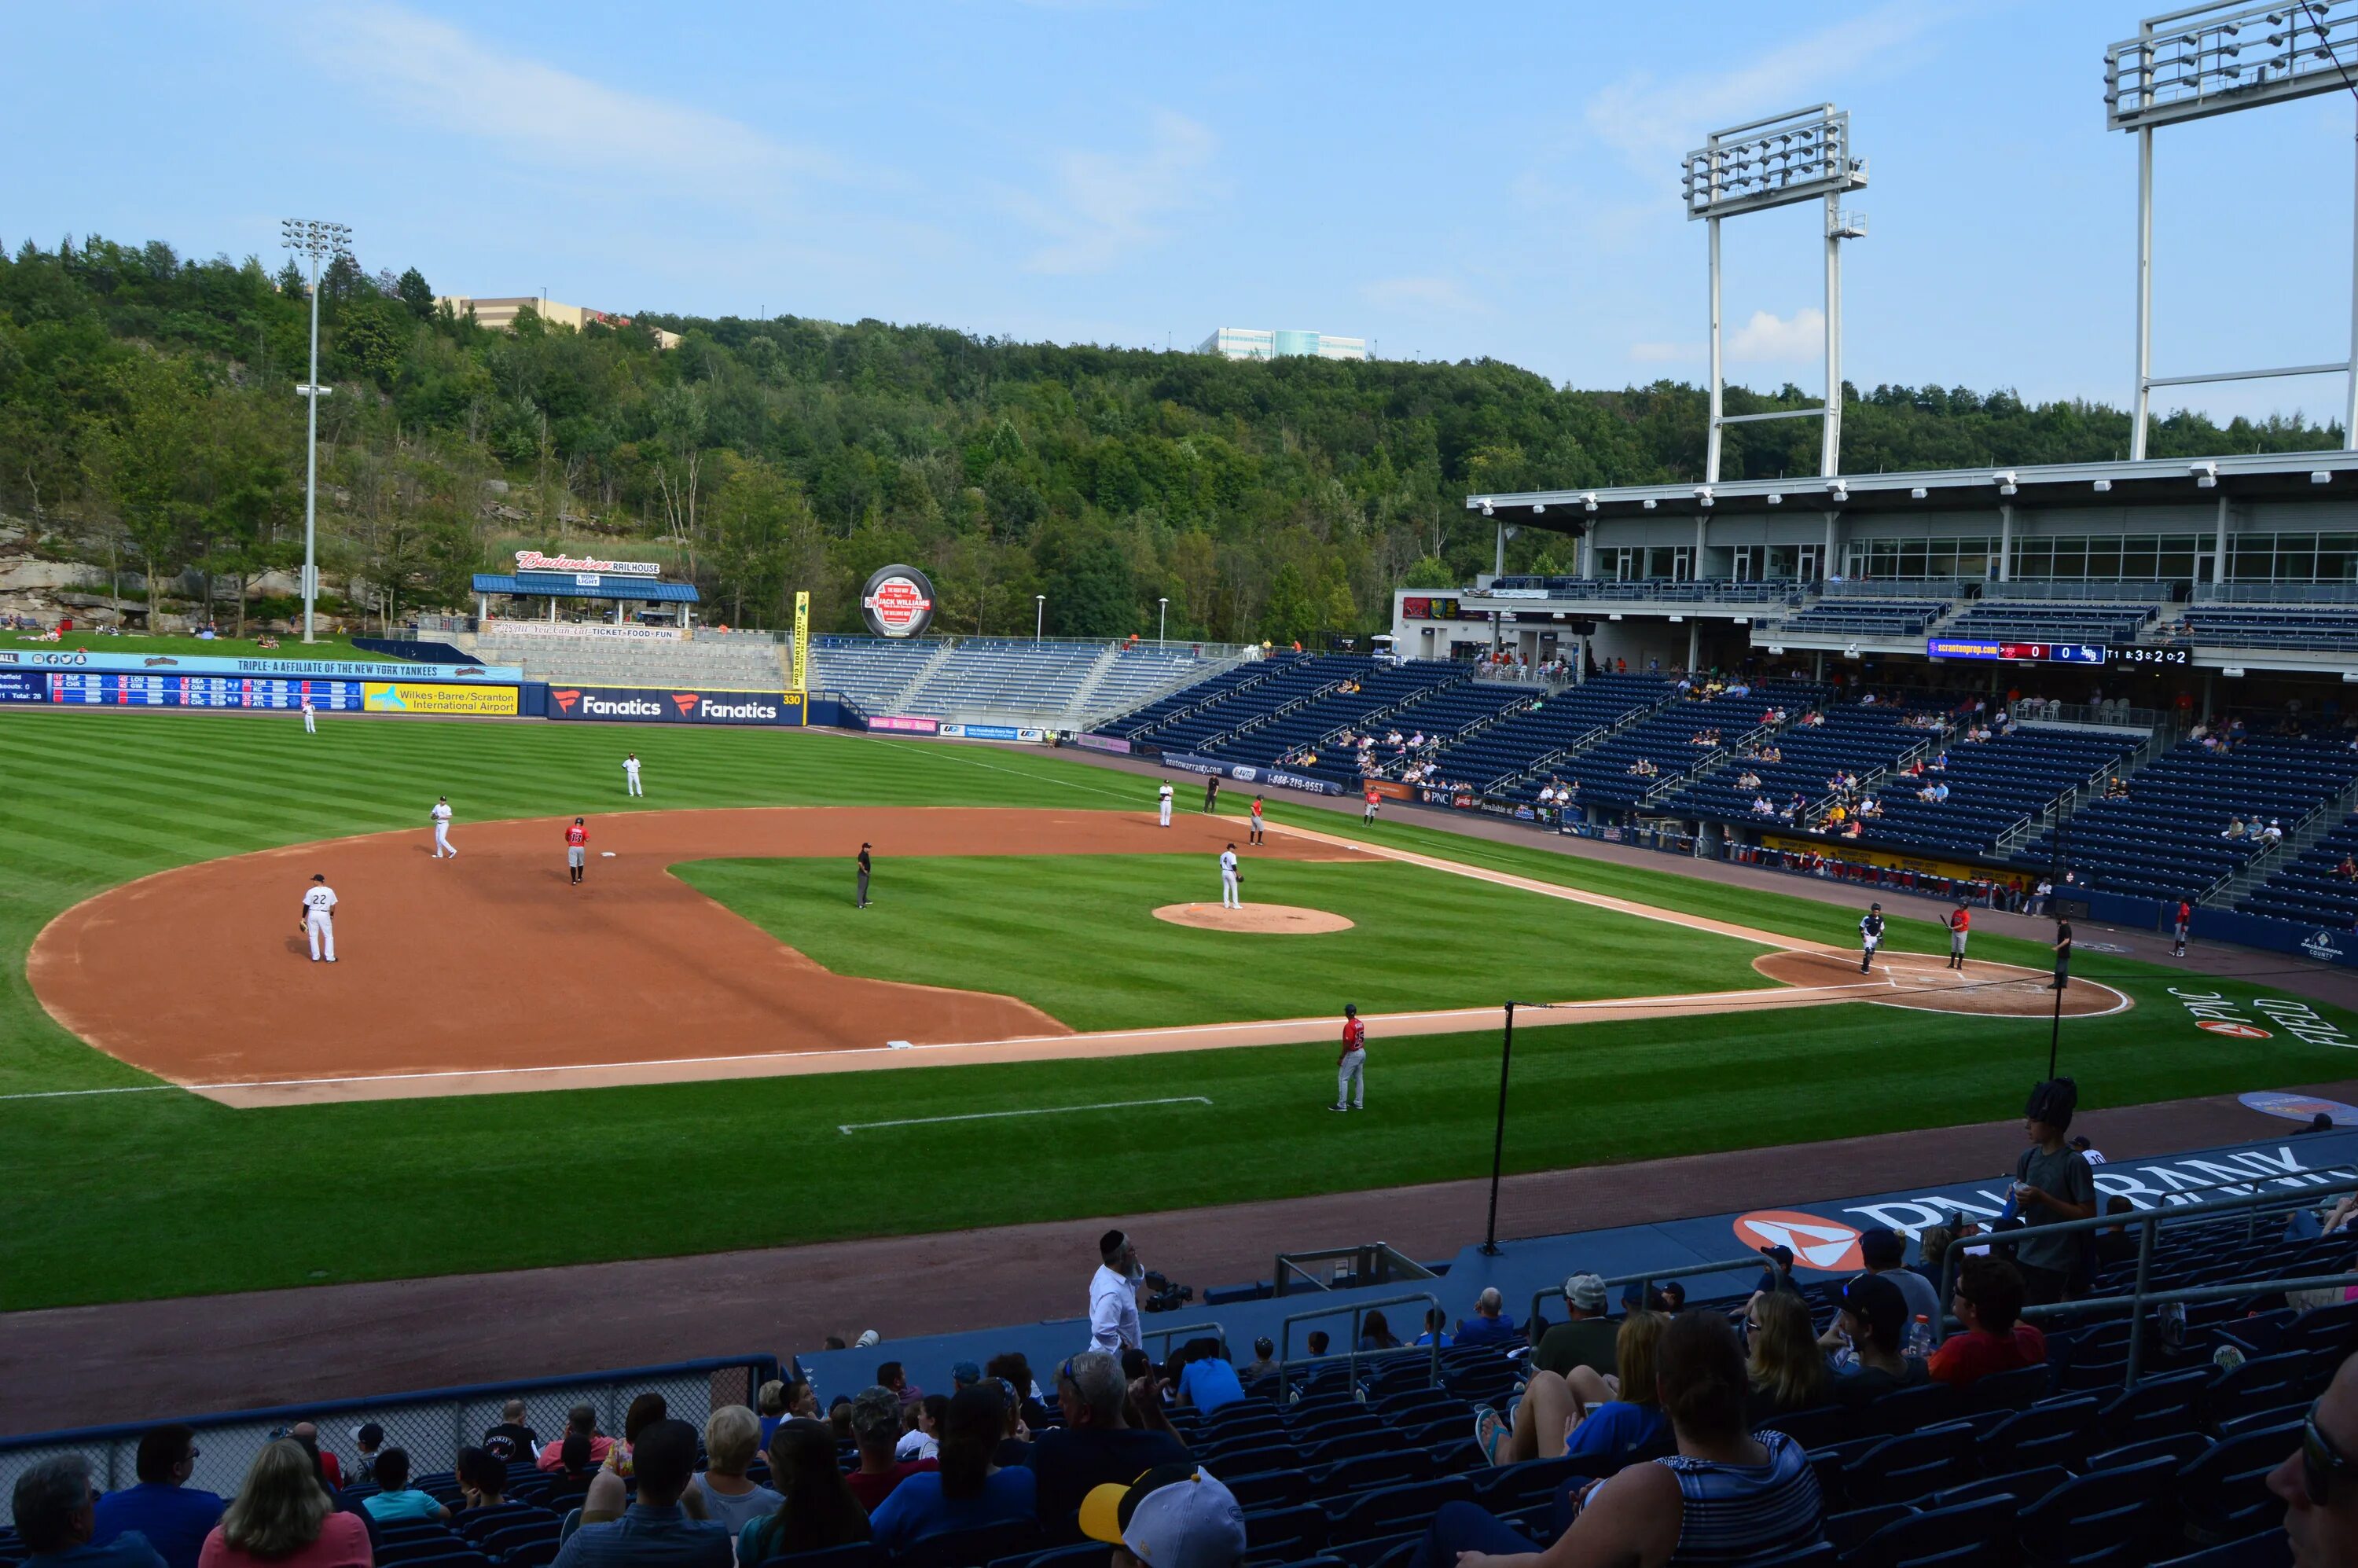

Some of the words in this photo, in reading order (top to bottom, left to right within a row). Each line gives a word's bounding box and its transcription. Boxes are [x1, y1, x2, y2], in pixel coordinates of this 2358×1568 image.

[516, 551, 612, 571] Budweiser
[612, 563, 659, 573] RAILHOUSE
[534, 625, 549, 634] You
[1937, 644, 1997, 655] scrantonprep.com
[2032, 646, 2039, 657] 0
[2062, 647, 2070, 658] 0
[2081, 645, 2097, 662] SWB
[2126, 651, 2133, 659] B:
[2135, 649, 2143, 661] 3
[2154, 650, 2163, 662] 2
[2177, 651, 2185, 663] 2
[273, 662, 278, 671] A
[280, 662, 322, 673] AFFILIATE
[325, 663, 334, 673] OF
[338, 663, 352, 674] THE
[355, 664, 373, 675] NEW
[375, 665, 398, 676] YORK
[400, 666, 437, 677] YANKEES
[400, 690, 514, 702] Wilkes-Barre/Scranton
[783, 695, 801, 706] 330
[413, 701, 476, 710] International
[480, 702, 514, 712] Airport
[582, 696, 661, 716] Fanatics
[701, 700, 777, 719] Fanatics
[1165, 758, 1222, 775] eautowarranty.com
[1267, 773, 1324, 793] 1-888-219-9553
[1431, 791, 1449, 805] PNC
[1481, 802, 1506, 814] Available
[571, 833, 582, 843] 13
[313, 894, 327, 905] 22
[2309, 949, 2333, 959] COUNTY
[2166, 987, 2253, 1023] PNC
